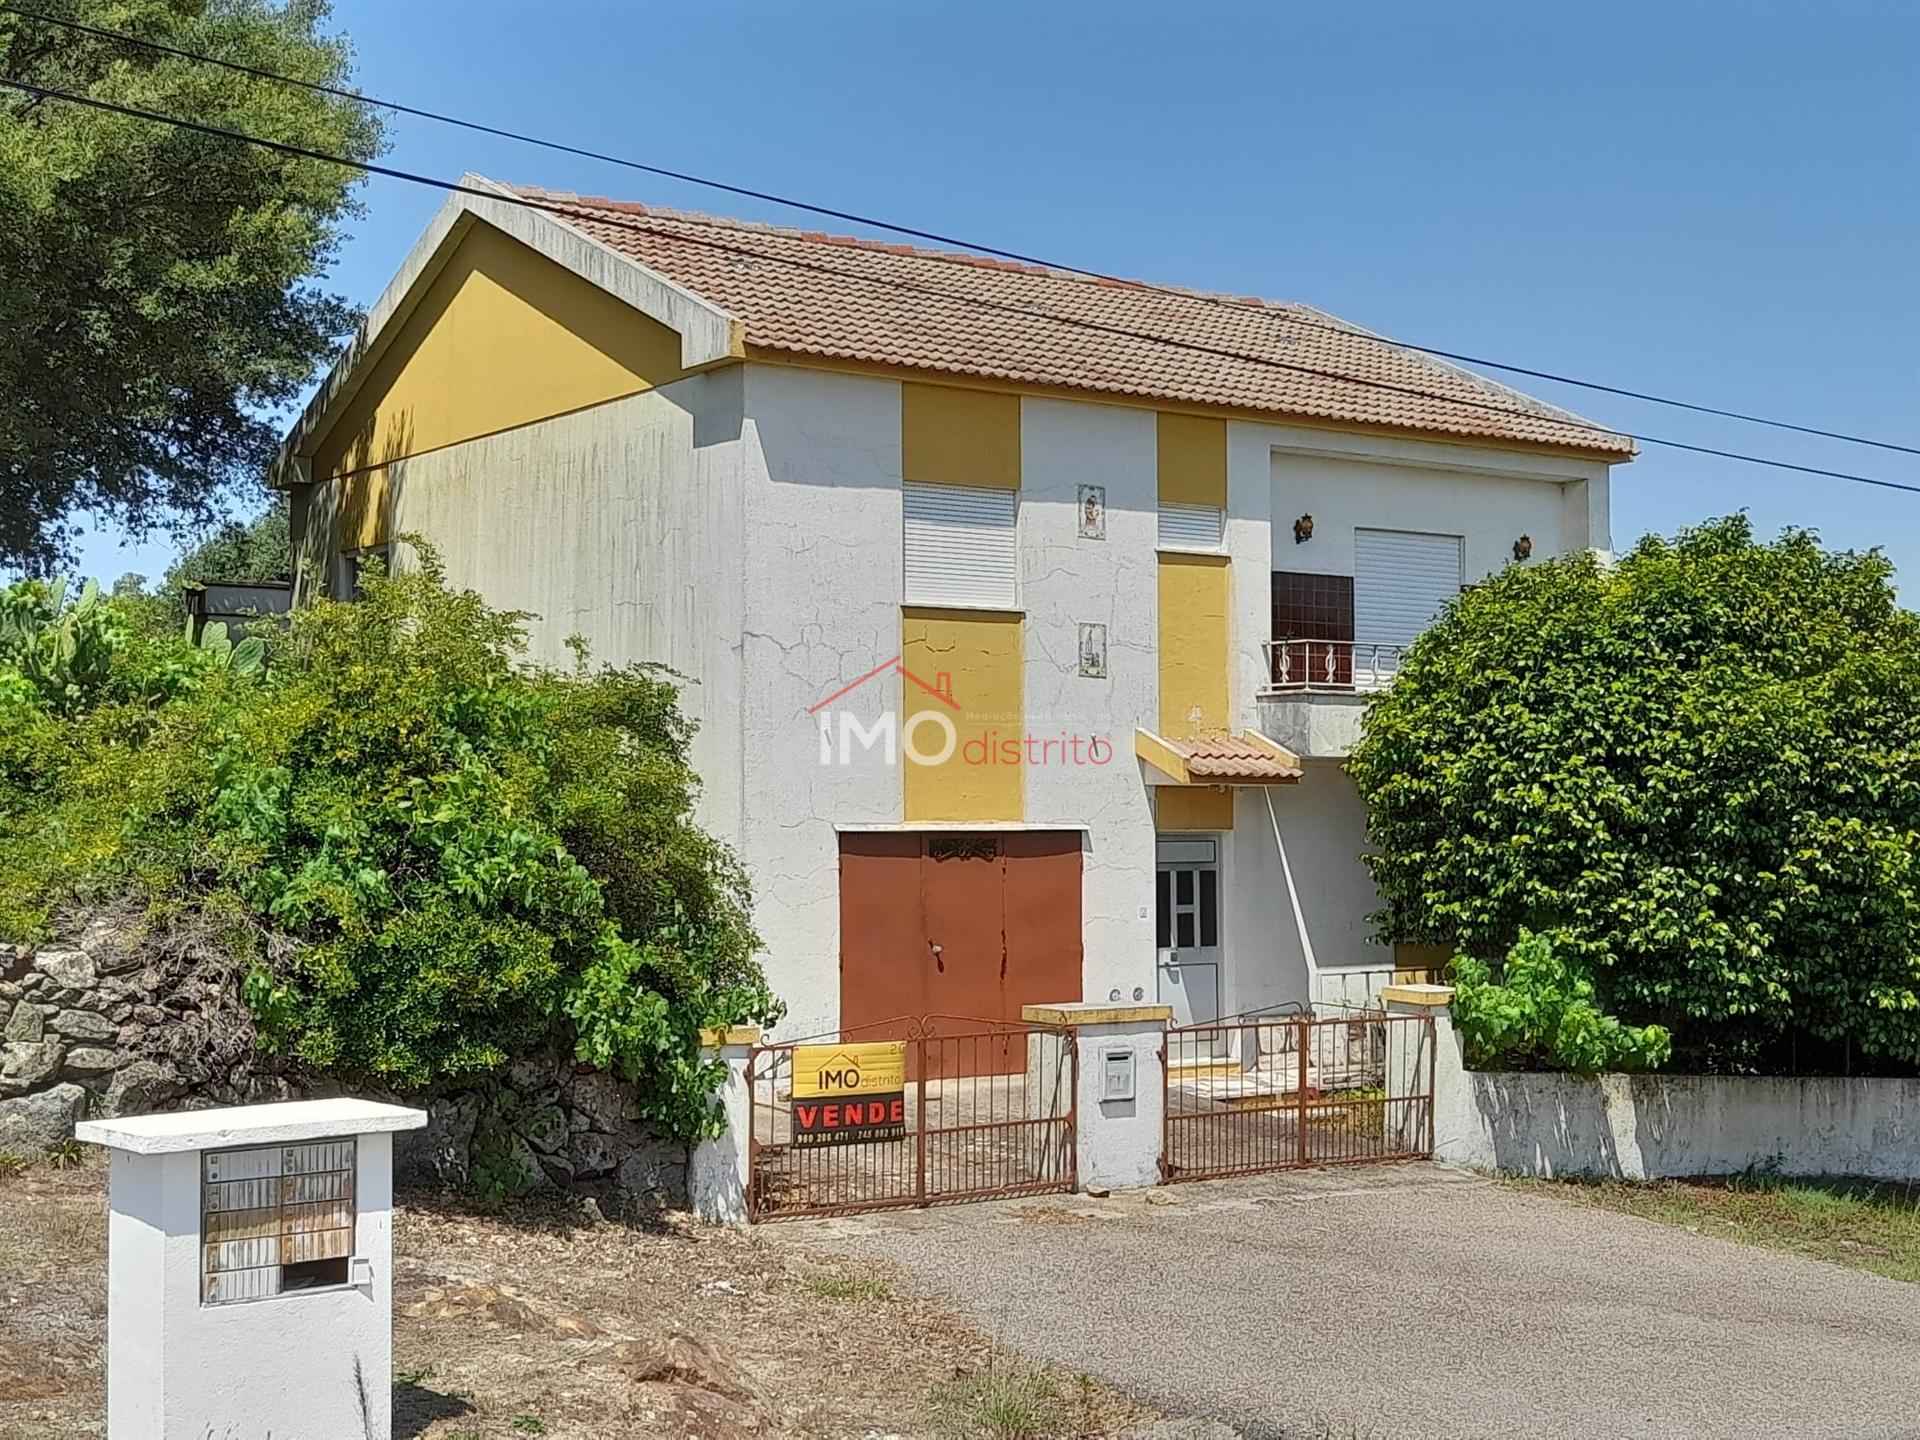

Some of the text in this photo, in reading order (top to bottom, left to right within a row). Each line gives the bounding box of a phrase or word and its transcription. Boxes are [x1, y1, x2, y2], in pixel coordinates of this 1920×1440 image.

[818, 1069, 901, 1089] IMO distrito
[796, 1100, 903, 1129] VENDE
